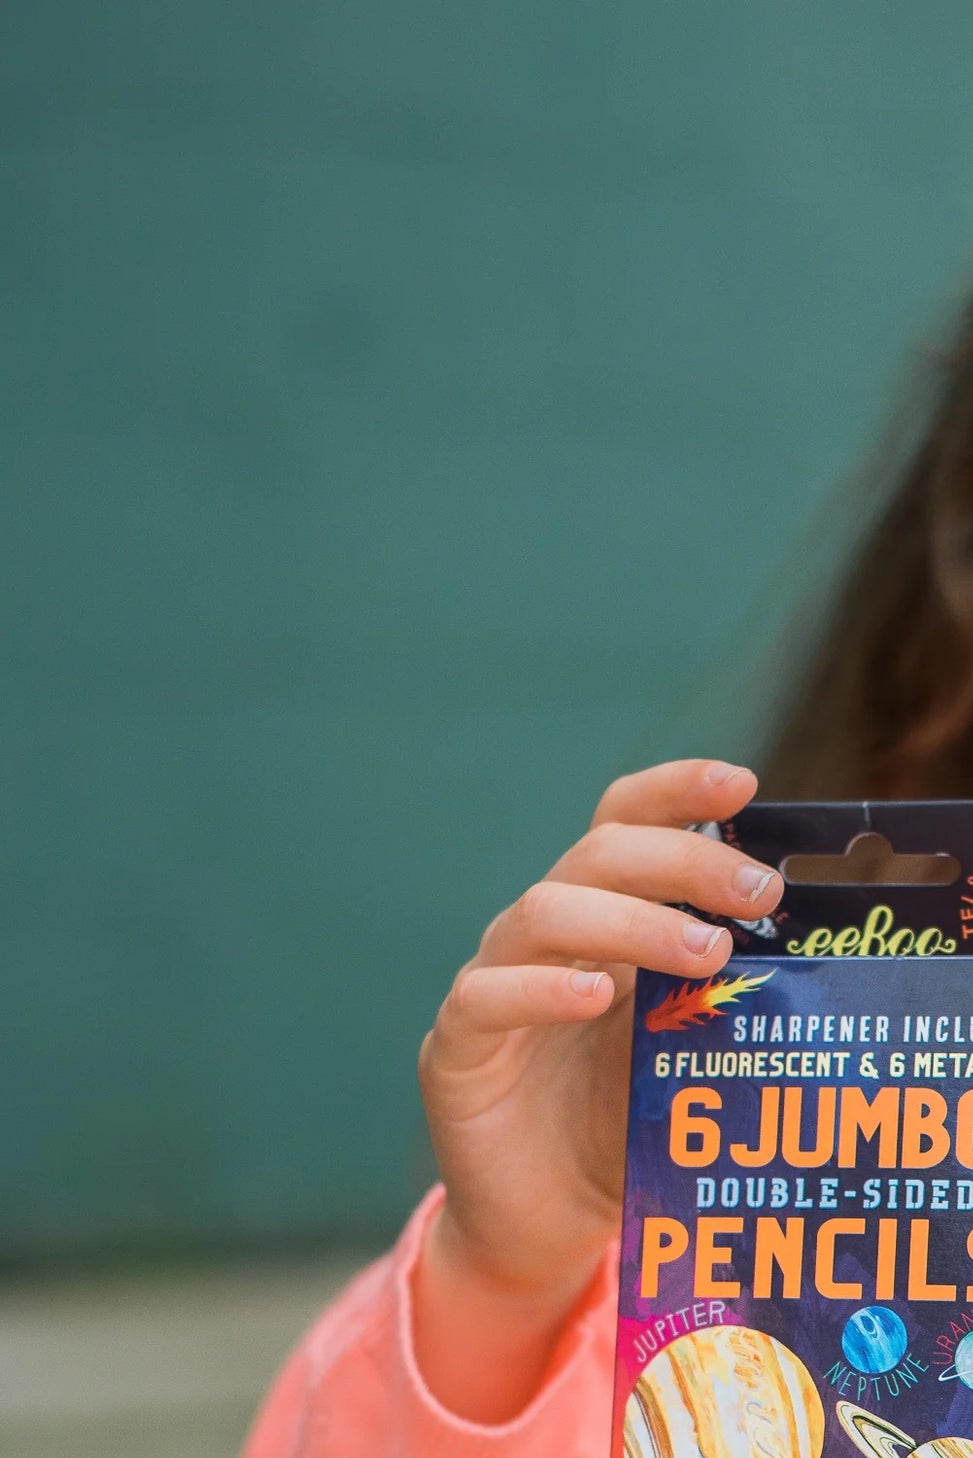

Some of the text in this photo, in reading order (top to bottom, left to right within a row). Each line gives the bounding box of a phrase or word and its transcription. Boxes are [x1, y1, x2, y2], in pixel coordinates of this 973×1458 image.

[733, 1015, 889, 1043] SHARPENER
[655, 1052, 671, 1078] 6
[675, 1052, 851, 1078] FLUORESCENT
[859, 1052, 879, 1079] &
[889, 1052, 906, 1078] 6
[669, 1086, 723, 1168] 6
[633, 1300, 726, 1363] JUPITER
[822, 1353, 930, 1401] NEPTUNE
